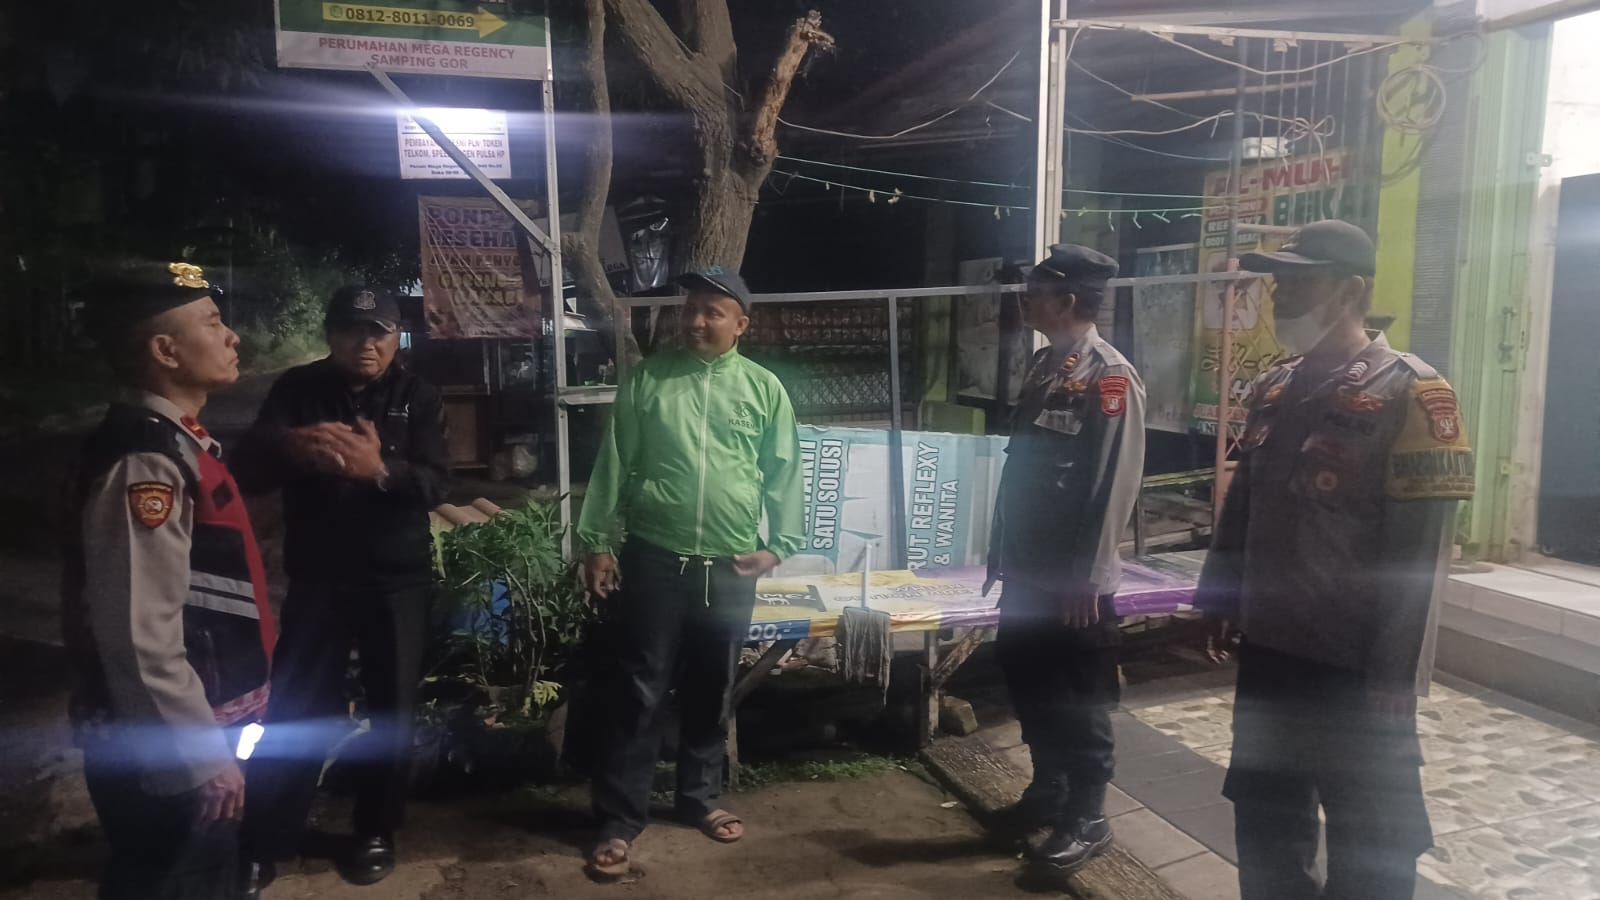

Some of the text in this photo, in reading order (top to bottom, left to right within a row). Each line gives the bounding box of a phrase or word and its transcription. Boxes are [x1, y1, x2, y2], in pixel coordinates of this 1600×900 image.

[345, 7, 475, 28] 0812-8011-0069
[319, 37, 515, 59] PERUMAHAN MEGA REGENCY
[371, 54, 469, 69] SAMPING GOR
[812, 439, 844, 550] SATU SOLUSI
[912, 441, 940, 529] REFLEXY
[934, 480, 959, 566] & WANITA
